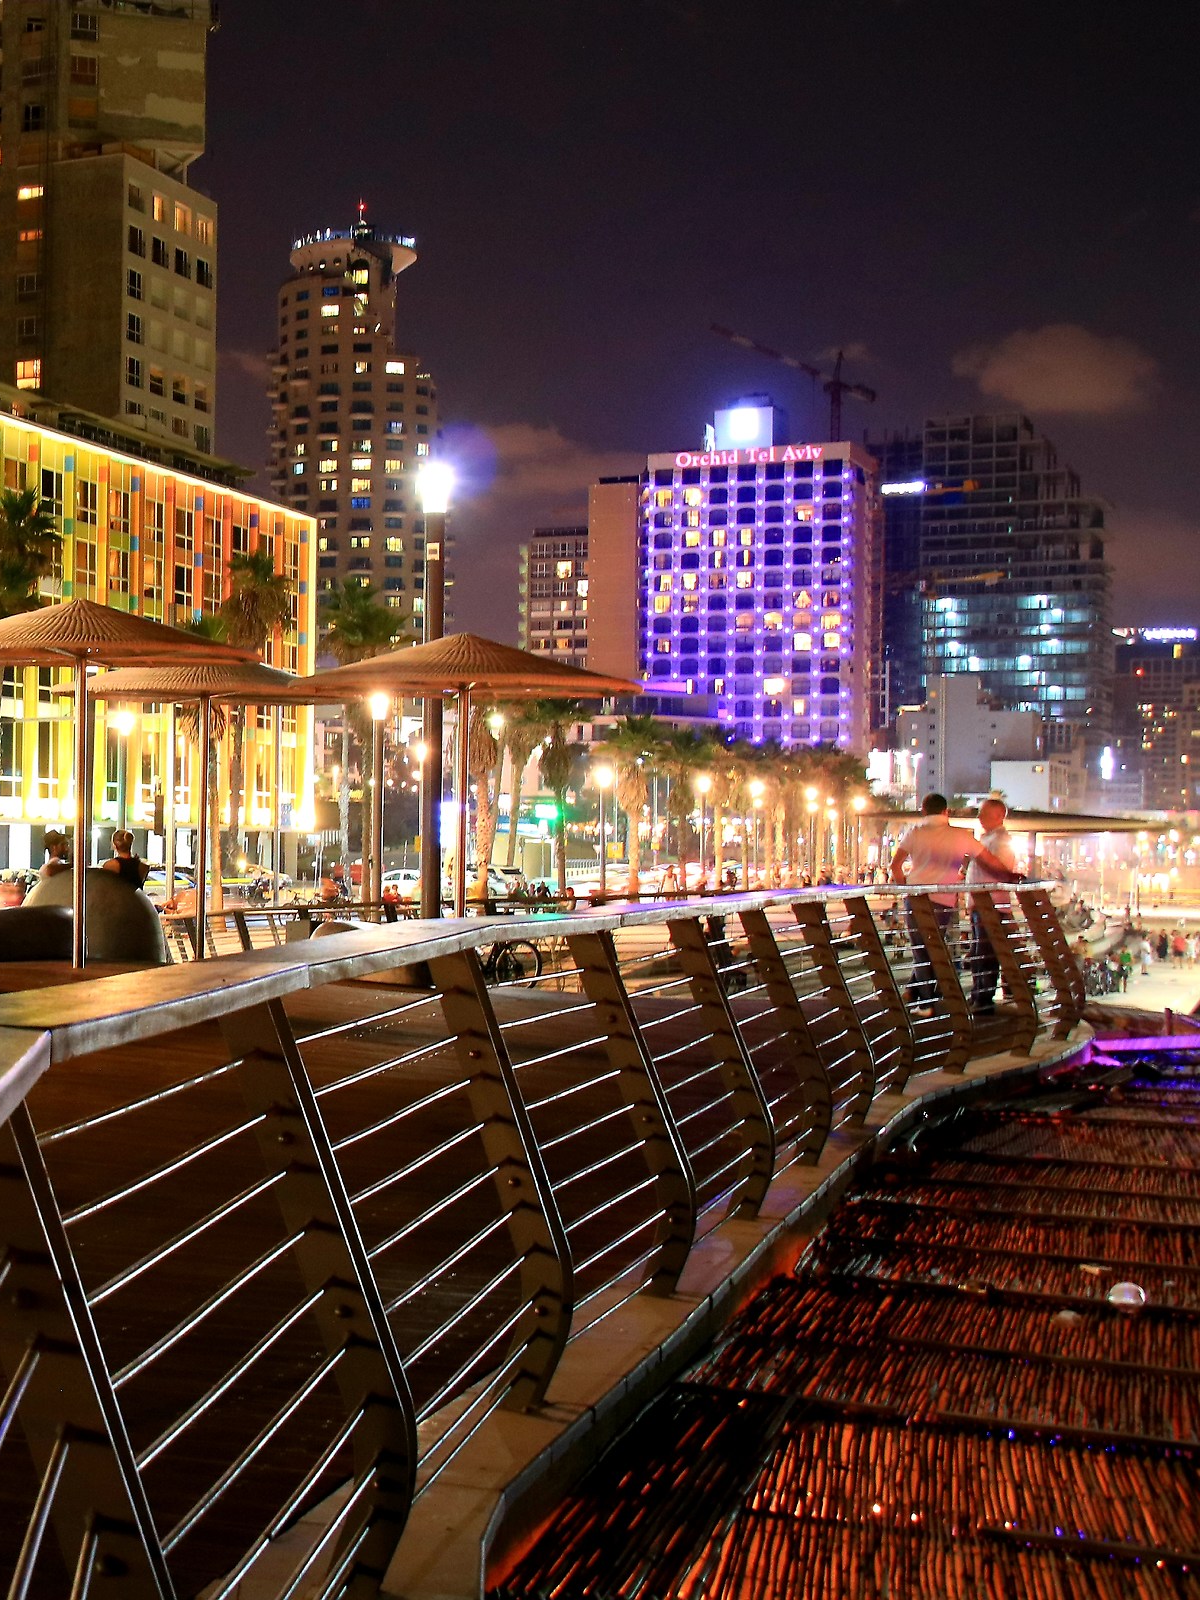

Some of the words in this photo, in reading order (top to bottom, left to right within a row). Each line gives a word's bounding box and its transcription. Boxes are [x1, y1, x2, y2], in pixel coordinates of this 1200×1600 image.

[675, 448, 739, 468] Orchid
[745, 446, 776, 463] Tel
[783, 445, 823, 461] Aviv
